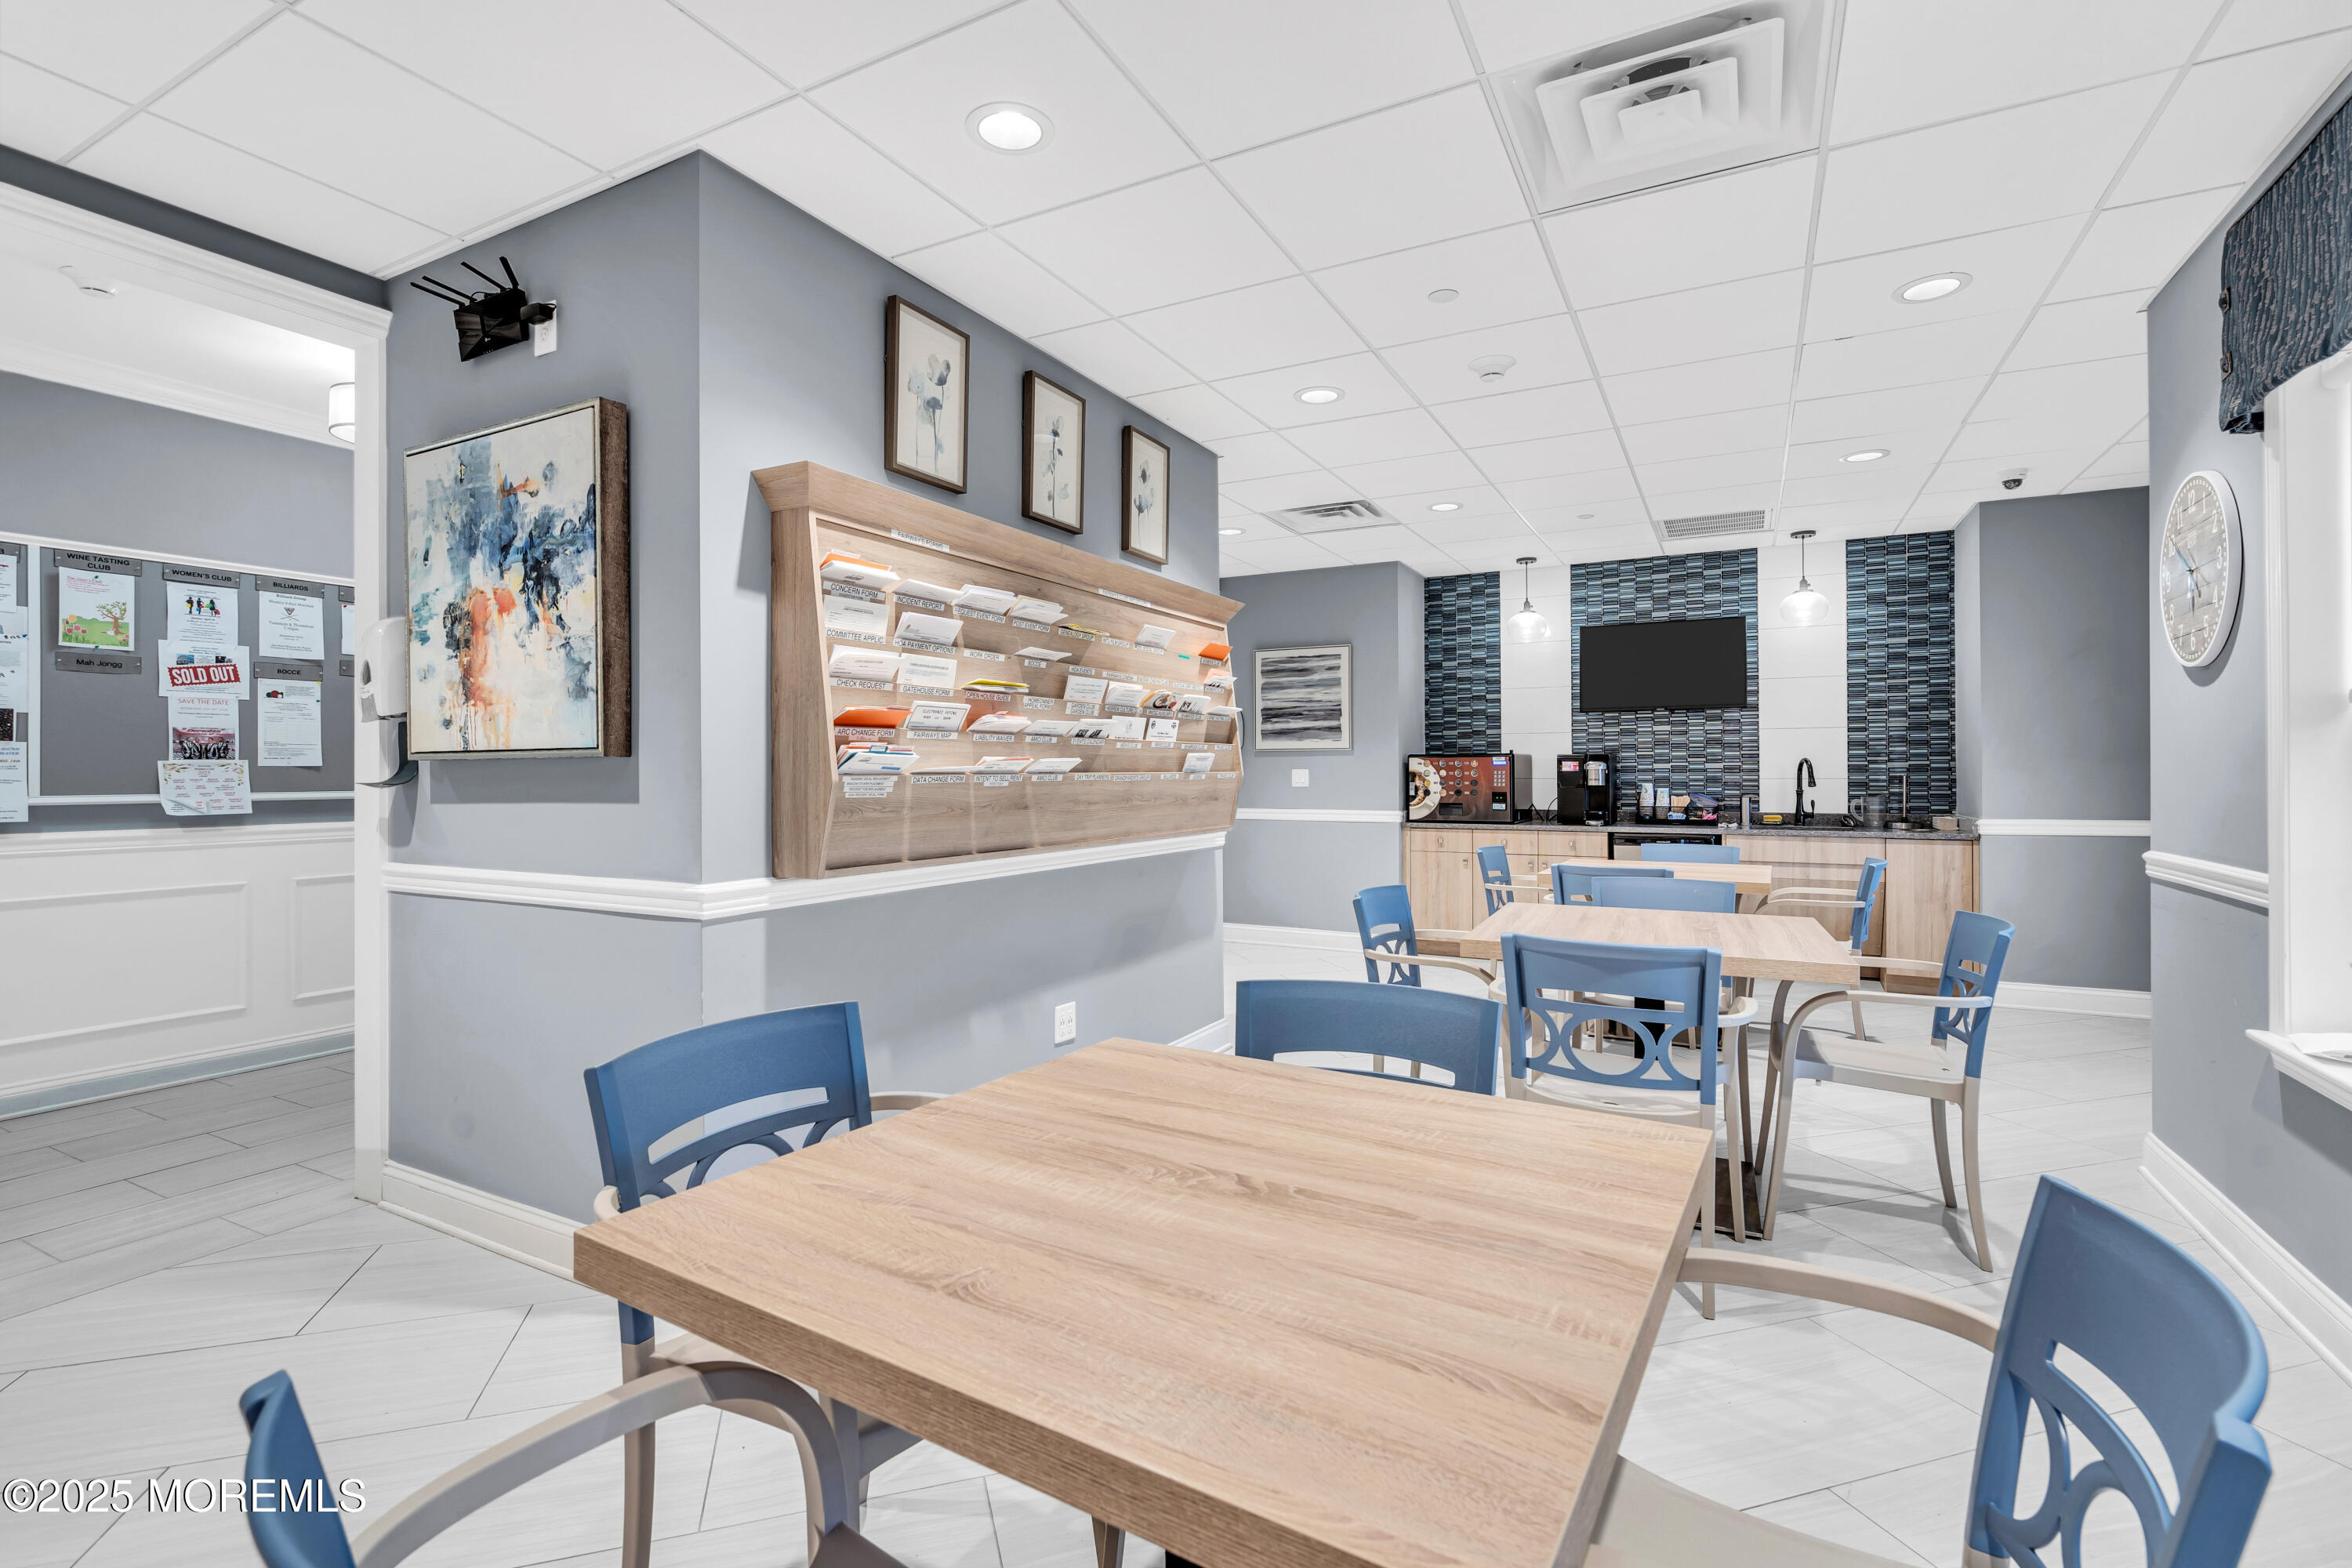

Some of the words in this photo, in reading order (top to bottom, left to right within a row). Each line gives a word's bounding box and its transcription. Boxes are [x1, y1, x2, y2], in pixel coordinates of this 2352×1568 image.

[2187, 489, 2195, 514] 12
[2176, 506, 2183, 530] 11
[2211, 510, 2218, 534] 2
[925, 539, 944, 550] FORMS
[2169, 535, 2176, 557] 10
[67, 553, 92, 561] WINE
[93, 556, 130, 566] TASTING
[2216, 545, 2223, 569] 3
[87, 562, 111, 571] CLUB
[172, 569, 210, 579] WOMEN'S
[273, 582, 308, 591] BILLIARDS
[2166, 571, 2171, 593] 9
[830, 583, 861, 596] CONCERN
[861, 589, 878, 598] FORM
[2212, 584, 2219, 608] 4
[897, 595, 921, 606] INCIDENT
[921, 601, 943, 610] REPORT
[954, 607, 976, 617] REQUEST
[2169, 604, 2174, 625] 8
[2203, 615, 2209, 637] 5
[826, 629, 862, 641] COMMITTEE
[862, 634, 884, 644] APPLIC
[2178, 624, 2183, 646] 7
[2190, 628, 2196, 651] 6
[907, 641, 931, 651] PAYMENT
[931, 645, 954, 654] OPTIONS
[96, 660, 122, 669] Jongg
[172, 668, 208, 684] SOLD
[209, 666, 235, 682] OUT
[858, 681, 886, 690] REQUEST
[902, 685, 935, 695] GATEHOUSE
